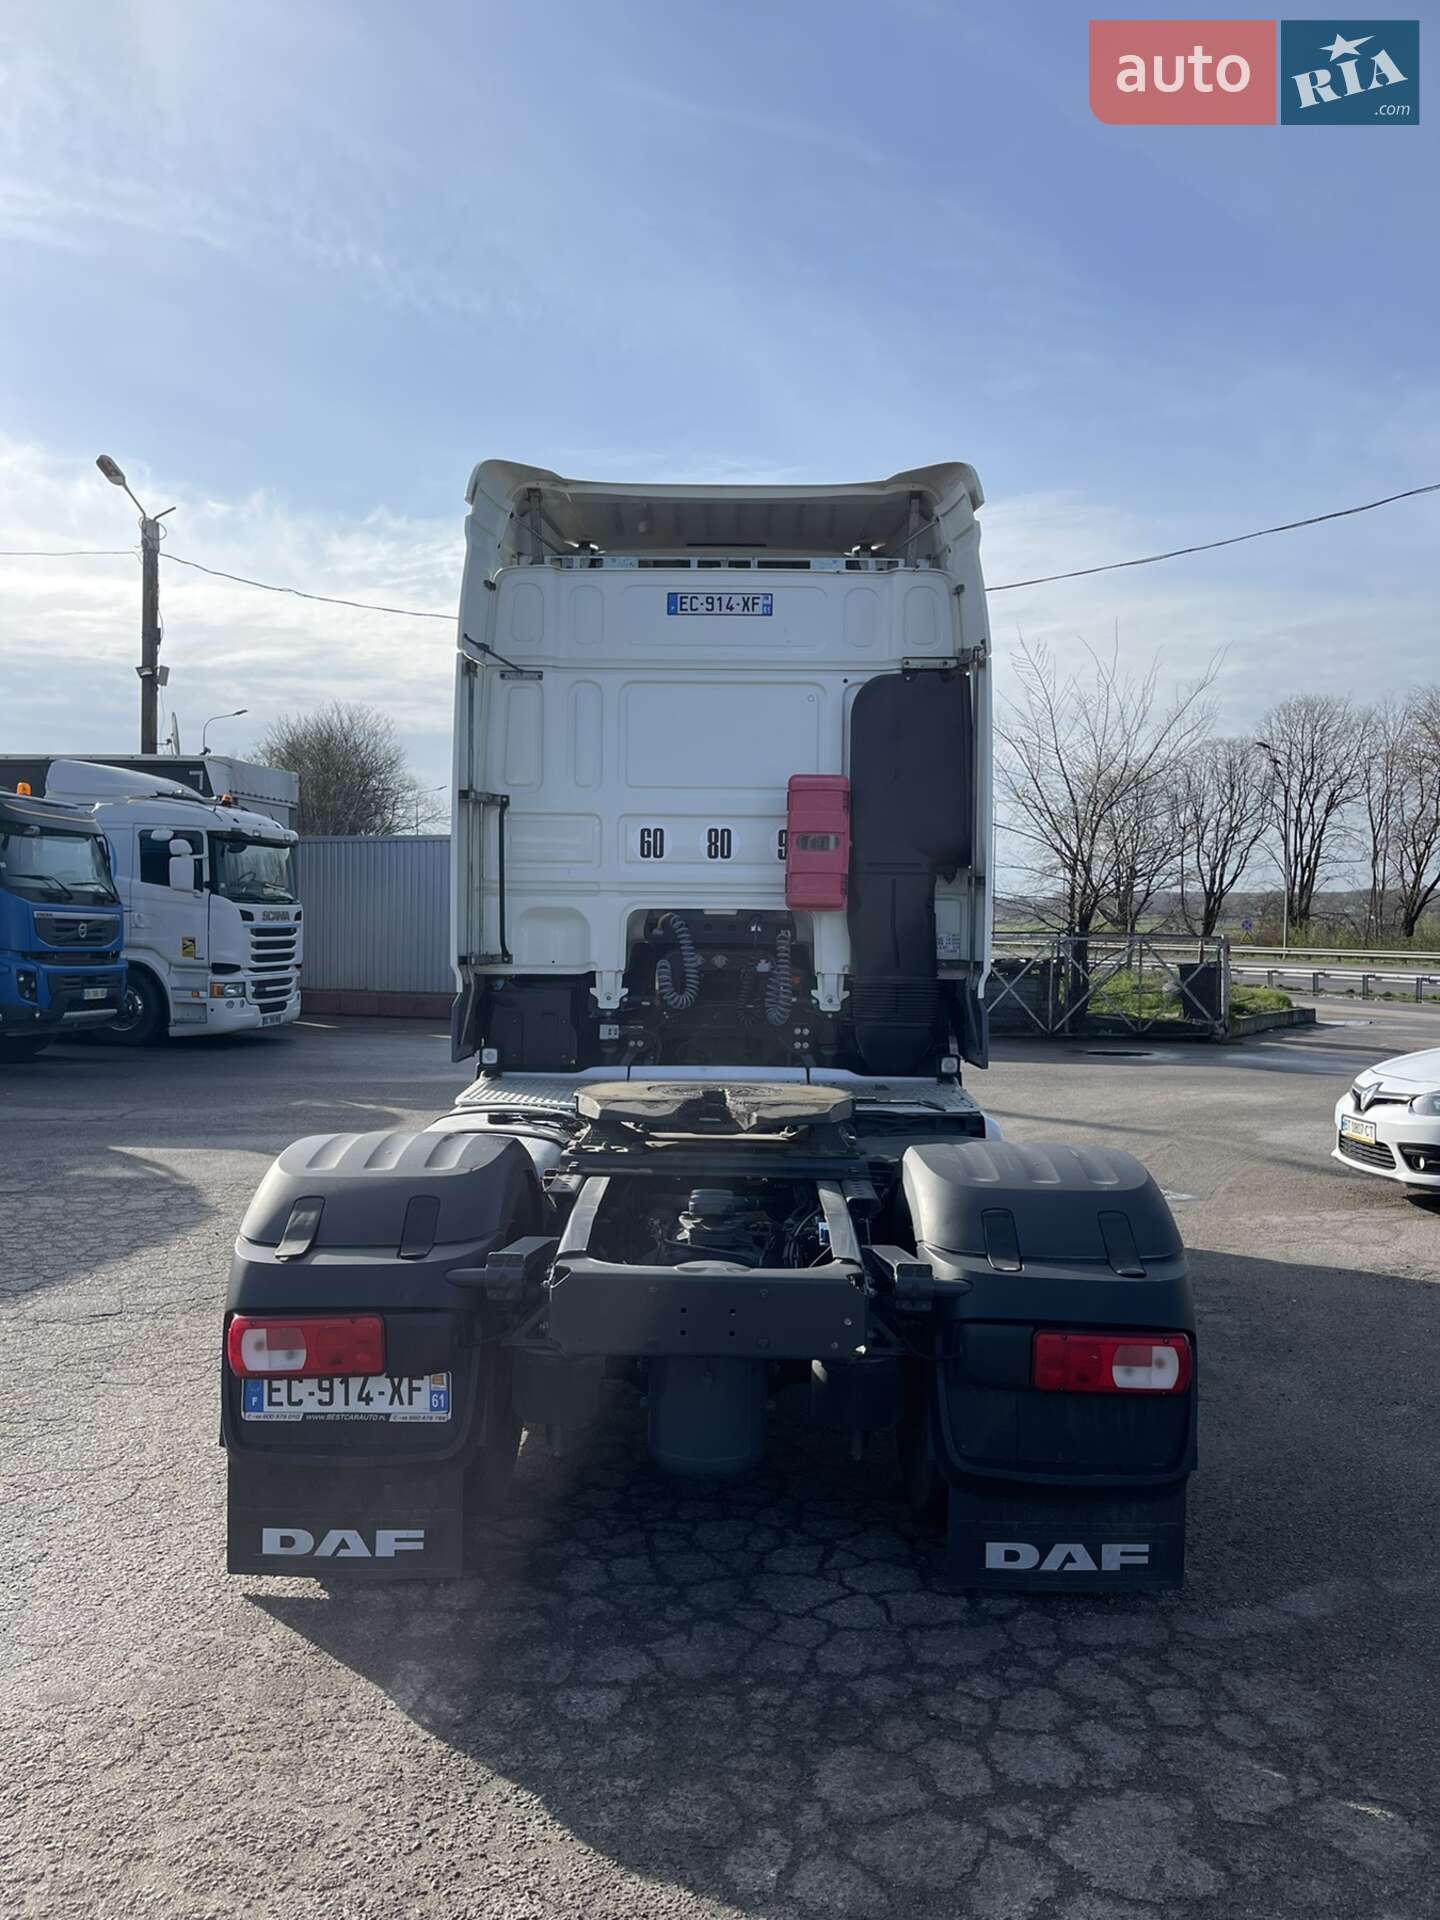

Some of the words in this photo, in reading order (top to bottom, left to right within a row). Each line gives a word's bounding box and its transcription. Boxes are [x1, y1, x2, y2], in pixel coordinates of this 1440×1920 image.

[679, 596, 761, 612] EC-914-XF
[640, 828, 664, 859] 60
[707, 828, 732, 859] 80
[778, 829, 788, 860] 9
[252, 1397, 258, 1406] F
[267, 1377, 424, 1407] EC-914-XF
[431, 1393, 445, 1408] 61
[262, 1528, 425, 1557] DAF
[985, 1542, 1150, 1571] DAF
